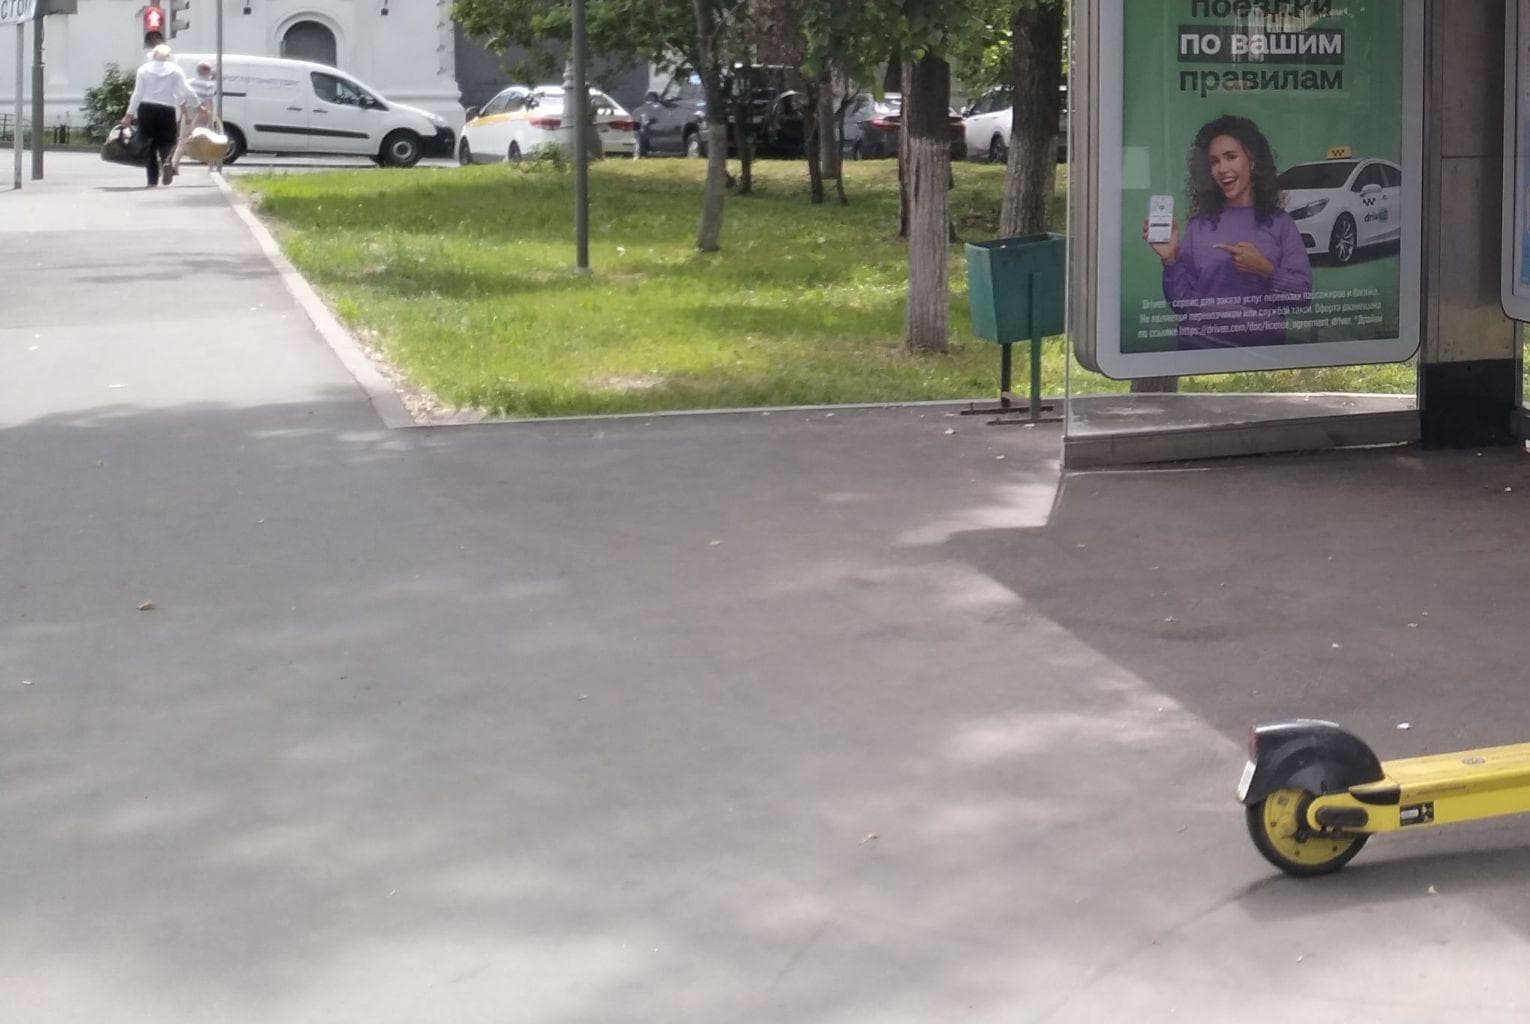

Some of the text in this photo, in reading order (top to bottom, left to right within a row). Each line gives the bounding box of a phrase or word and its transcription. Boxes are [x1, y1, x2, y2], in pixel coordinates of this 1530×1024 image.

[1180, 33, 1342, 55] по вашим
[1179, 70, 1343, 98] правилам
